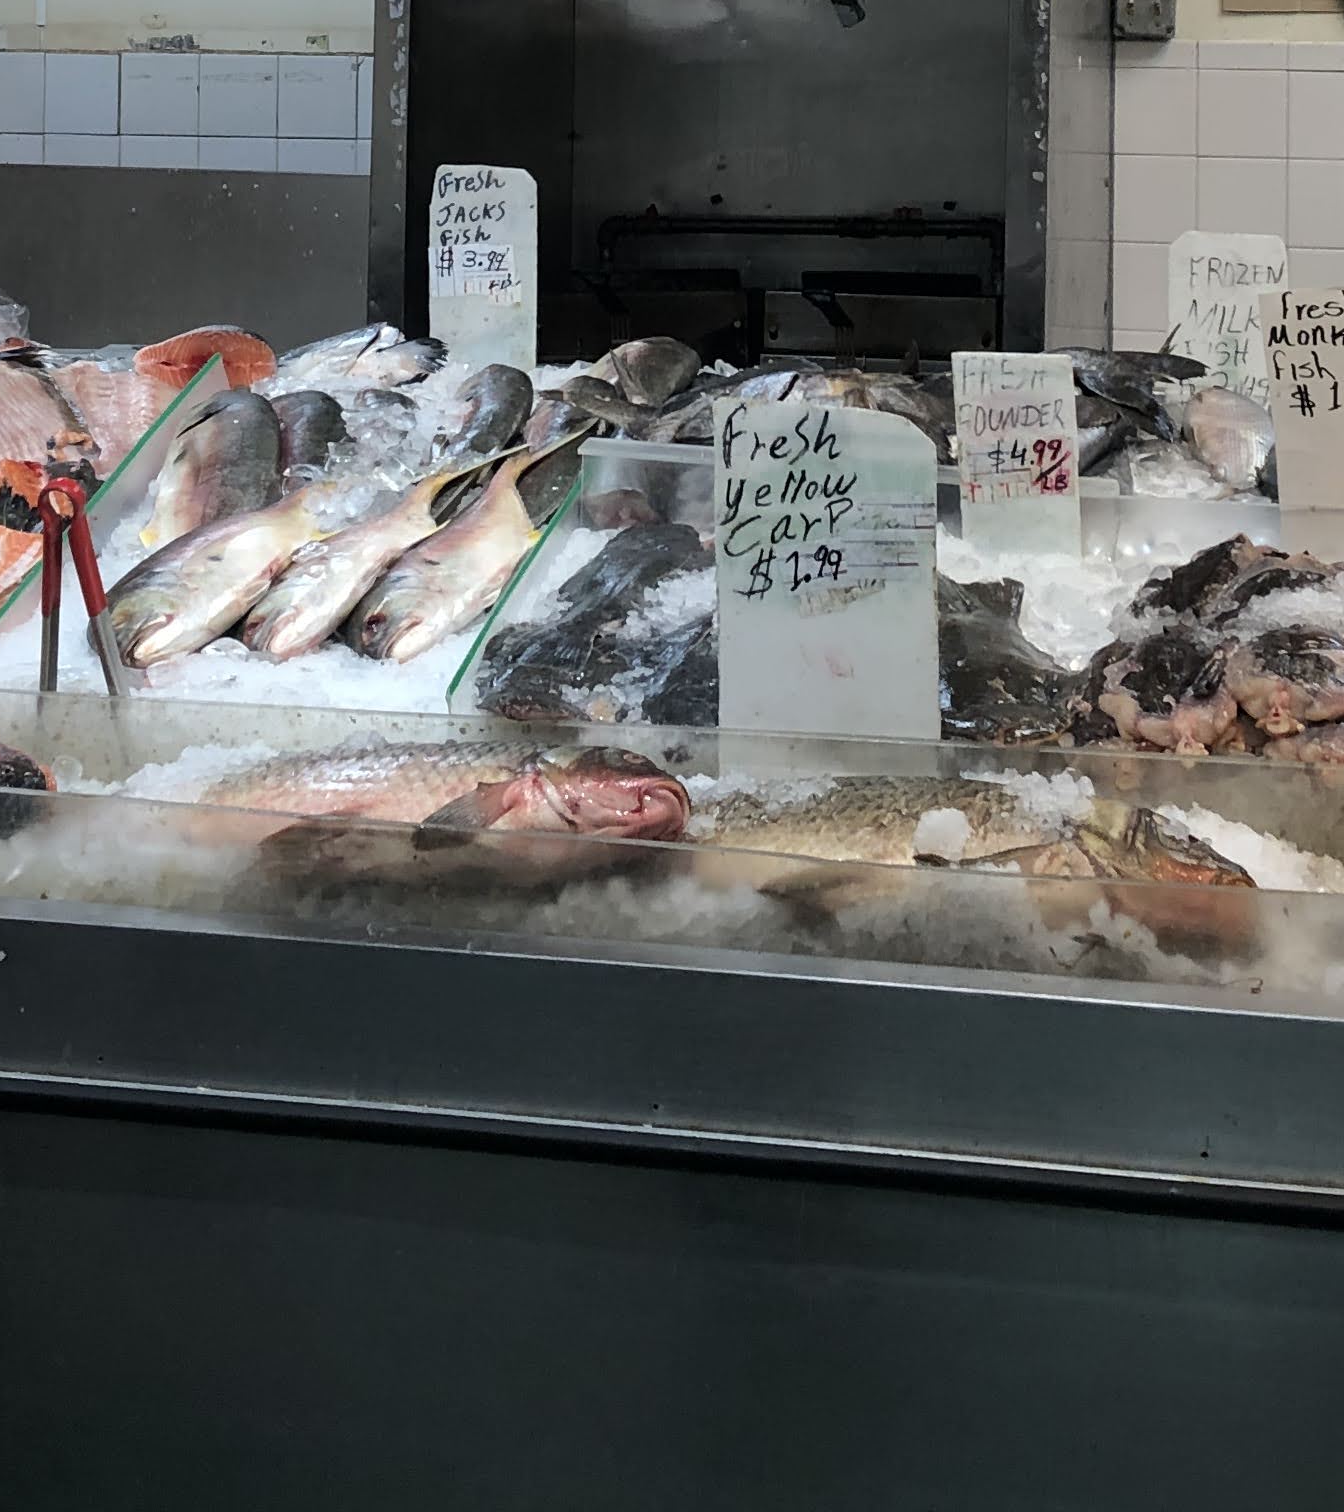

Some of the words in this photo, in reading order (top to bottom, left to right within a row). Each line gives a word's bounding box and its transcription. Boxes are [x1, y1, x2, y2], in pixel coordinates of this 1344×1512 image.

[436, 201, 506, 227] JACKS
[1190, 257, 1285, 288] FROZEN
[1188, 299, 1260, 336] MILK
